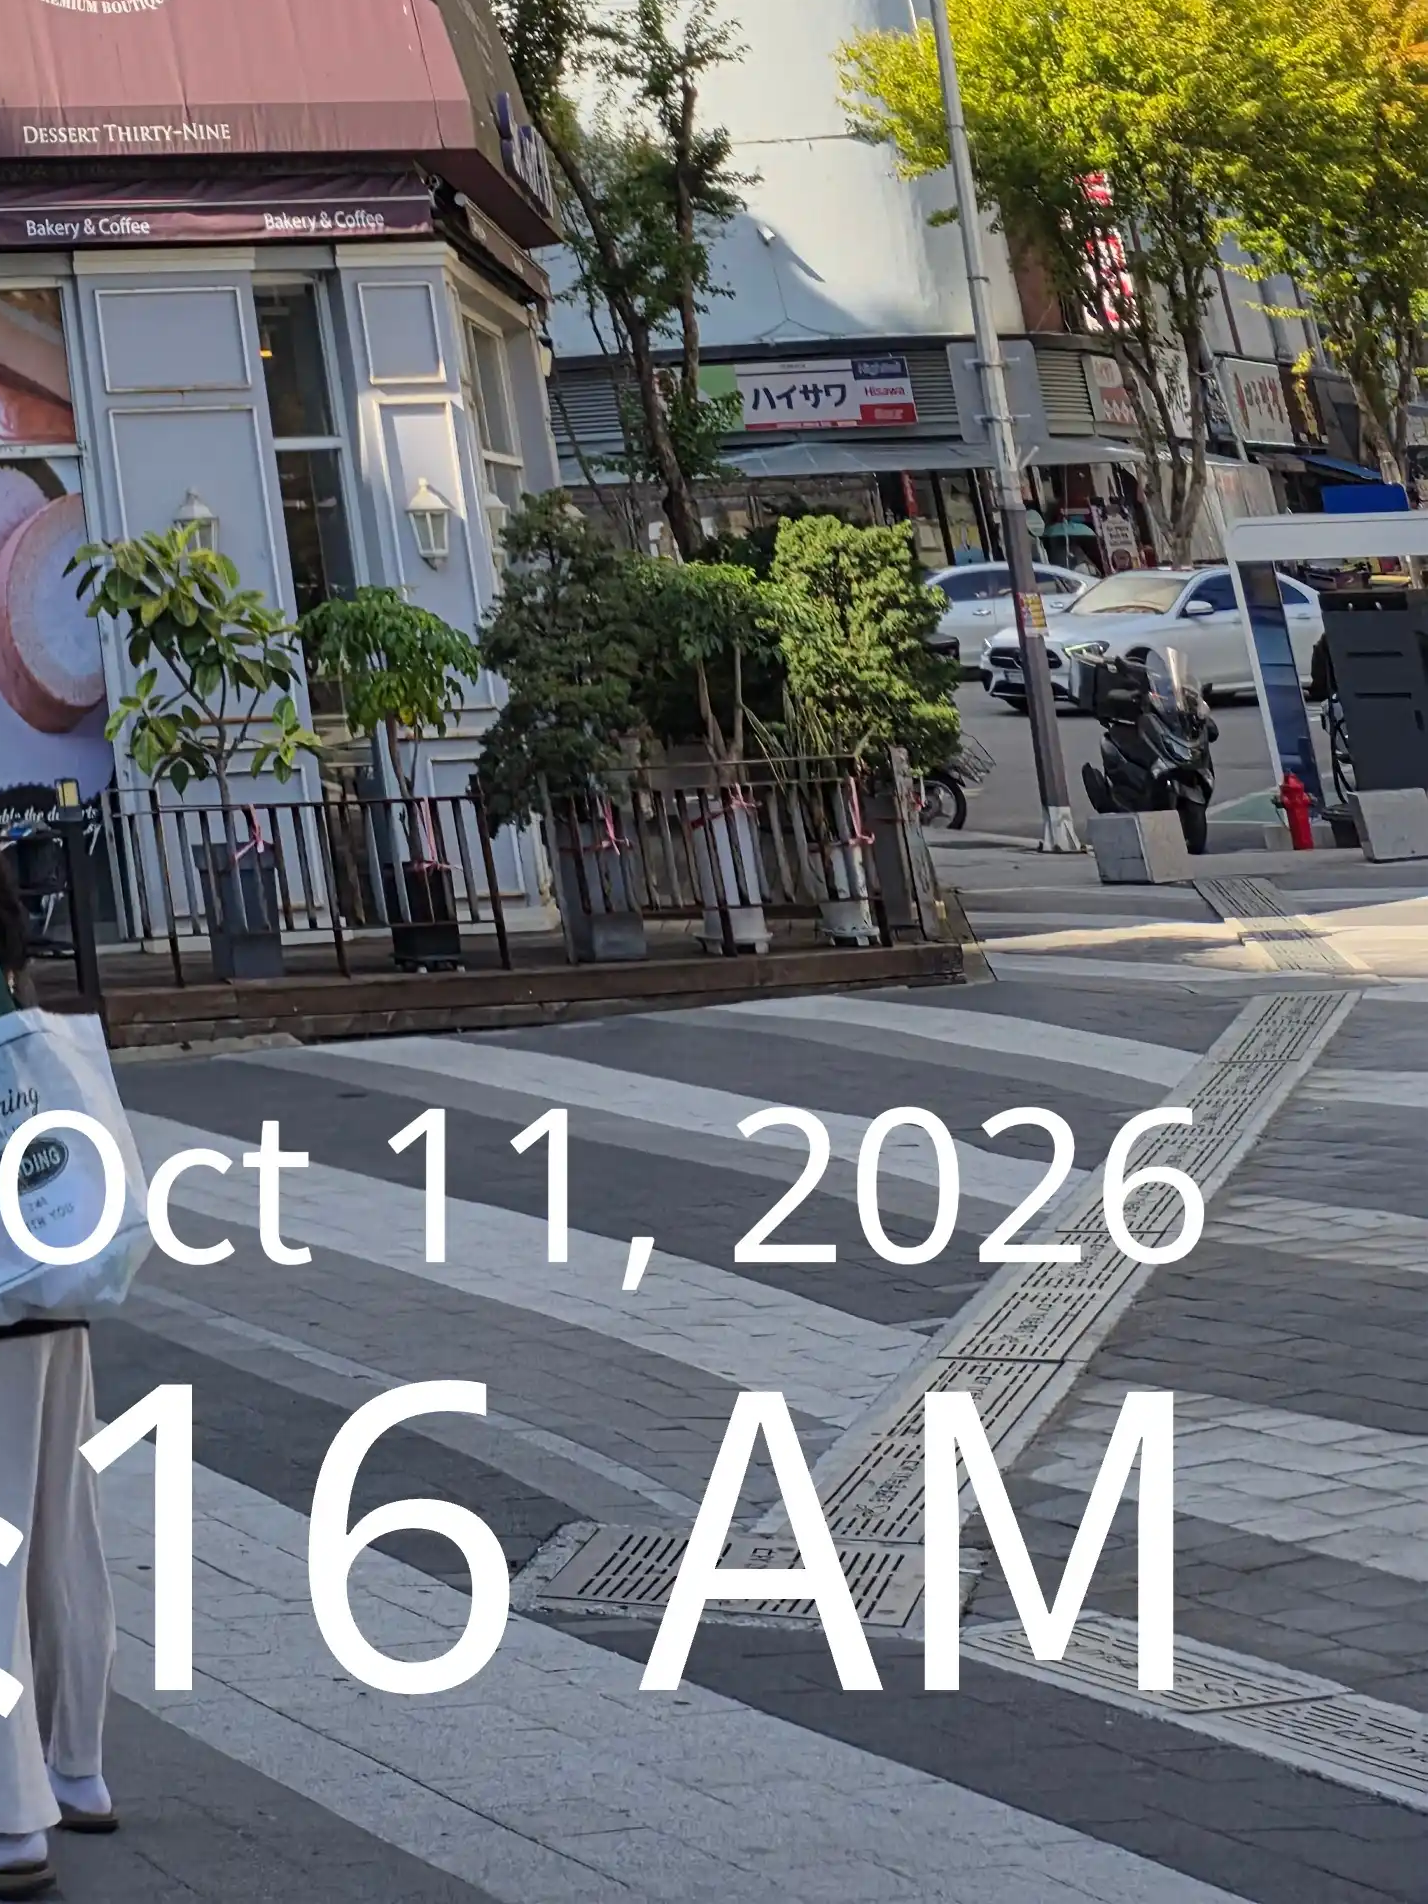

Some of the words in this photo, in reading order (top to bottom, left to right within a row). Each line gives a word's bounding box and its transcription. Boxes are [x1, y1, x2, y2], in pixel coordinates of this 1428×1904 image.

[26, 217, 80, 241] Bakery
[83, 219, 93, 235] &
[95, 216, 151, 237] Coffee
[263, 210, 317, 234] Bakery
[320, 212, 331, 229] &
[333, 208, 385, 229] Coffee
[751, 382, 847, 411] ハイサワ
